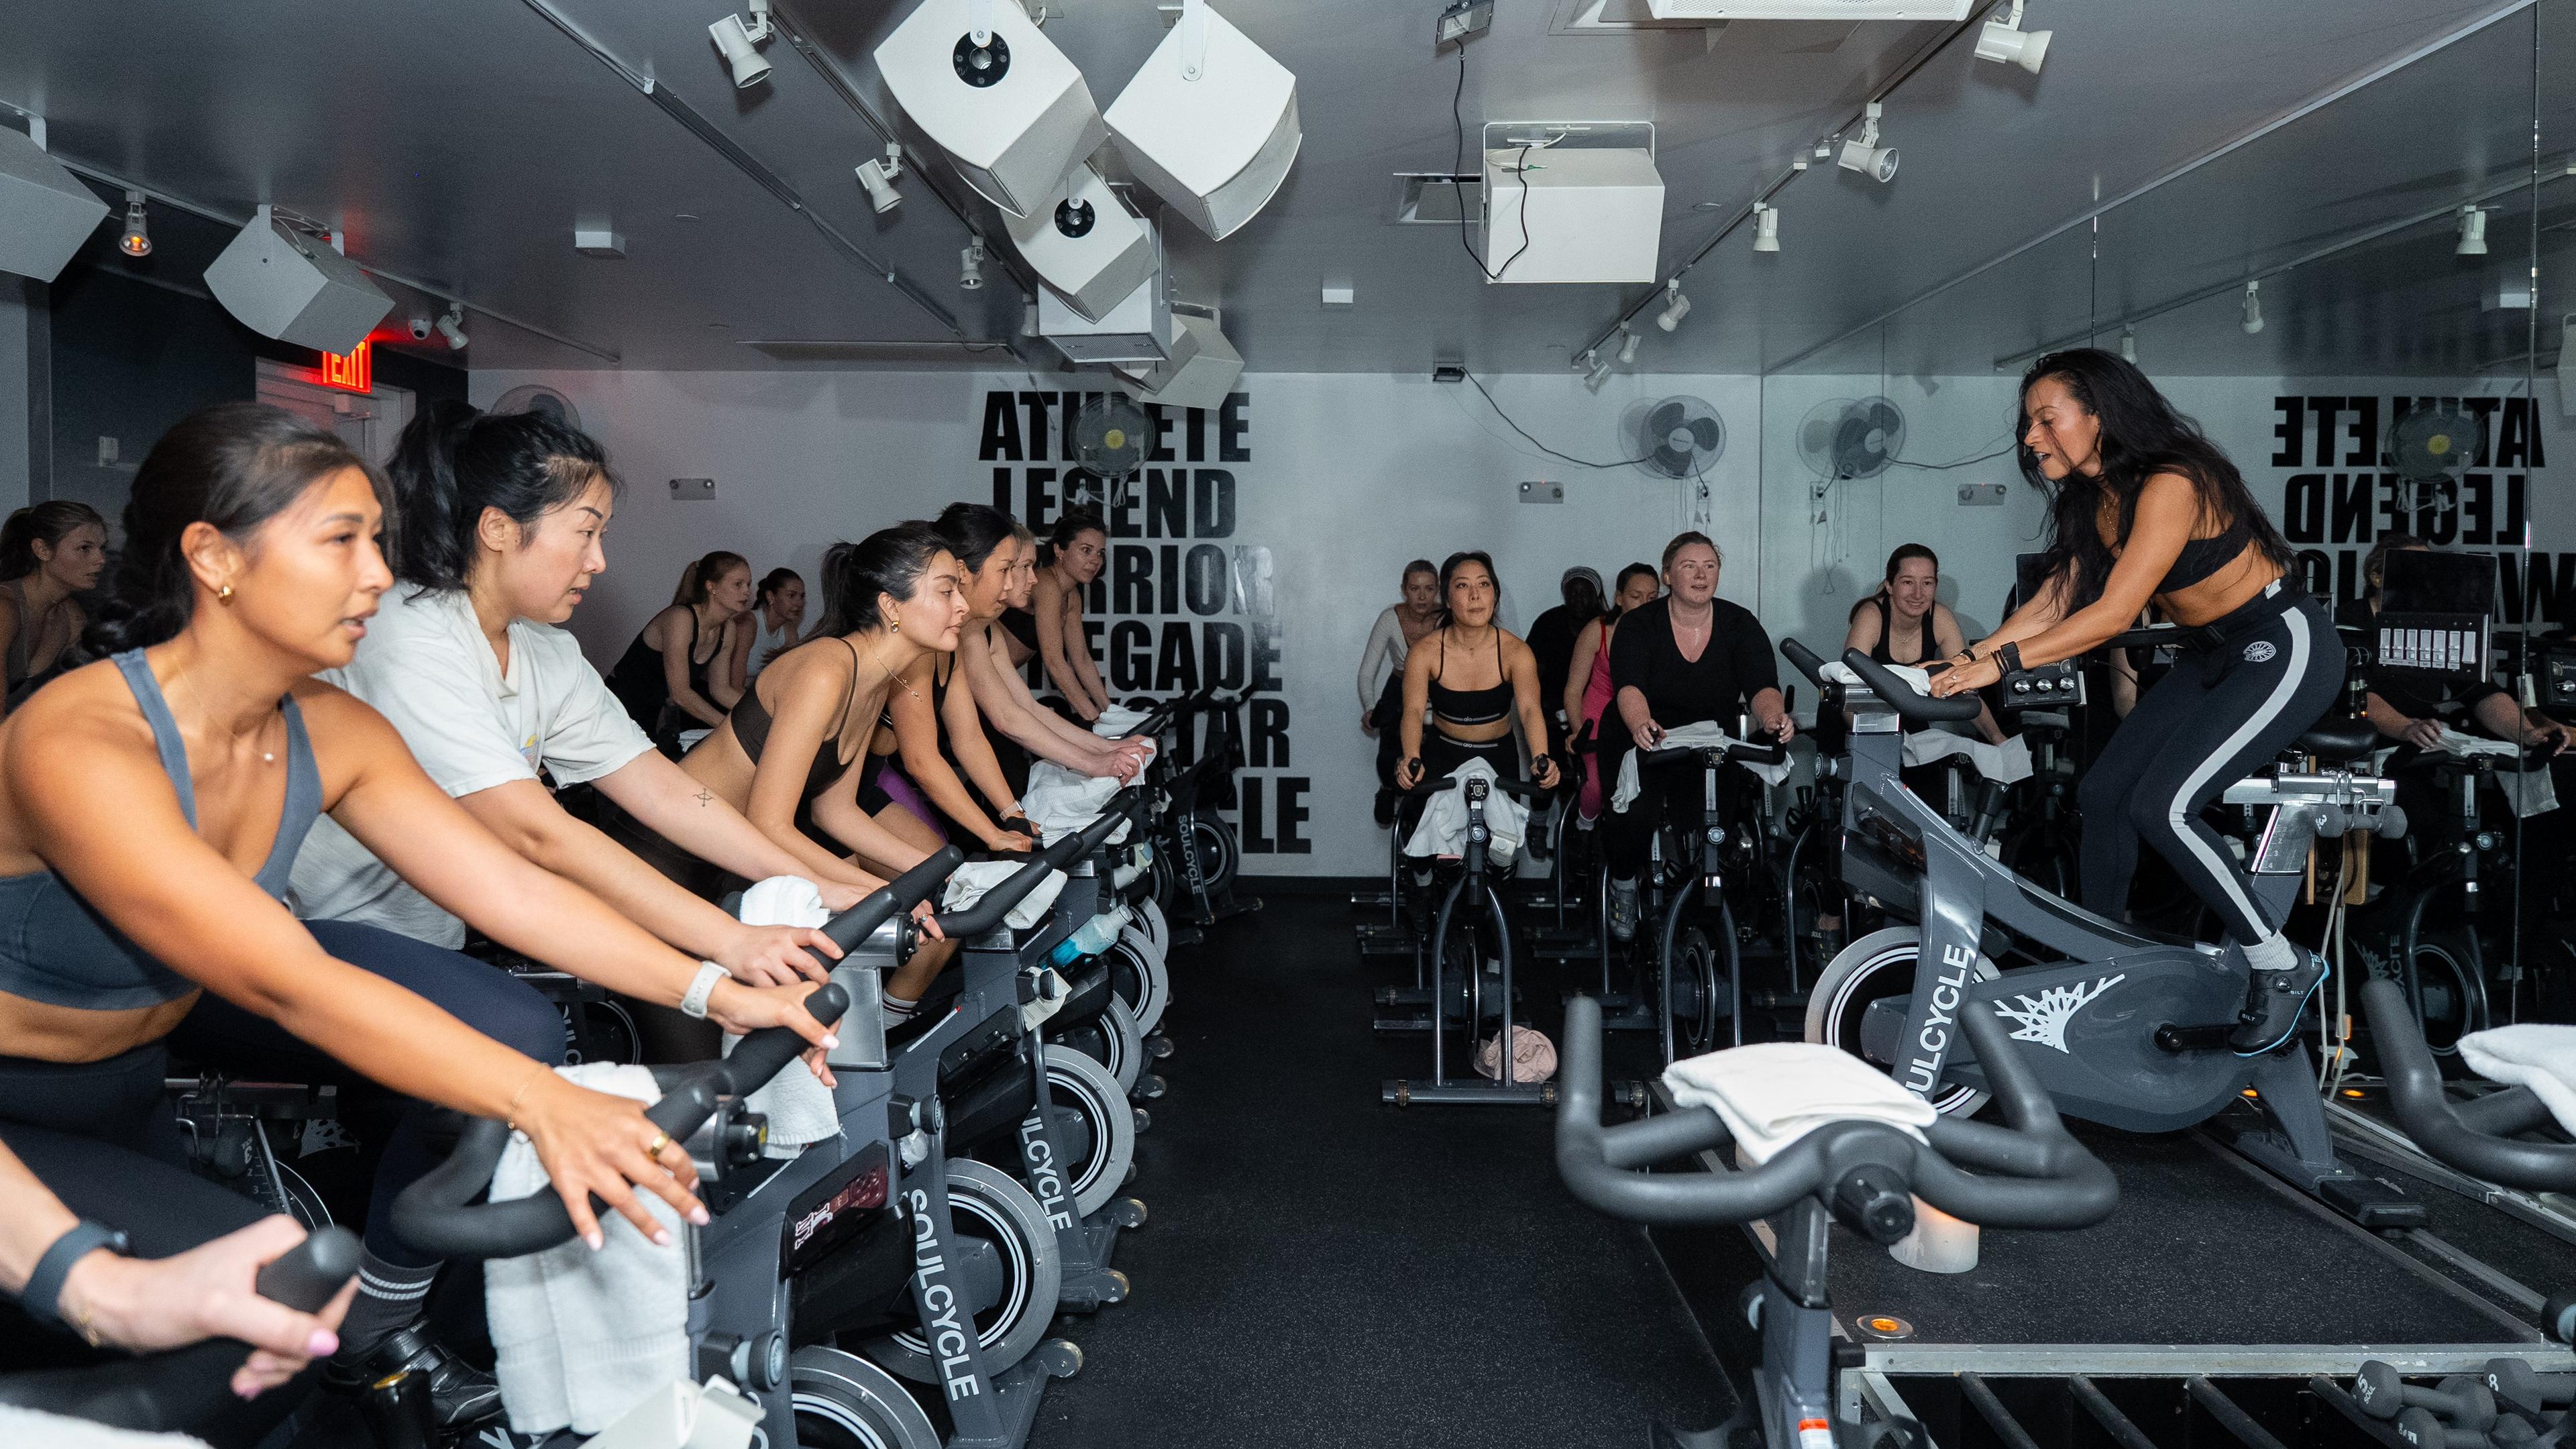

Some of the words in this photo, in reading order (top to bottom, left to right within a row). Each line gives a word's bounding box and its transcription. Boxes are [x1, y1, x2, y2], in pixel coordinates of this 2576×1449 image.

[331, 341, 366, 389] EXIT
[979, 391, 1250, 462] ATETE
[1178, 814, 1201, 895] SOULCYCLE
[1905, 944, 1970, 1101] ULCYCLE
[1021, 1105, 1073, 1232] LCYCLE
[910, 1189, 980, 1401] SOULCYCLE
[2357, 1373, 2368, 1393] 5
[2363, 1385, 2376, 1404] SOUL
